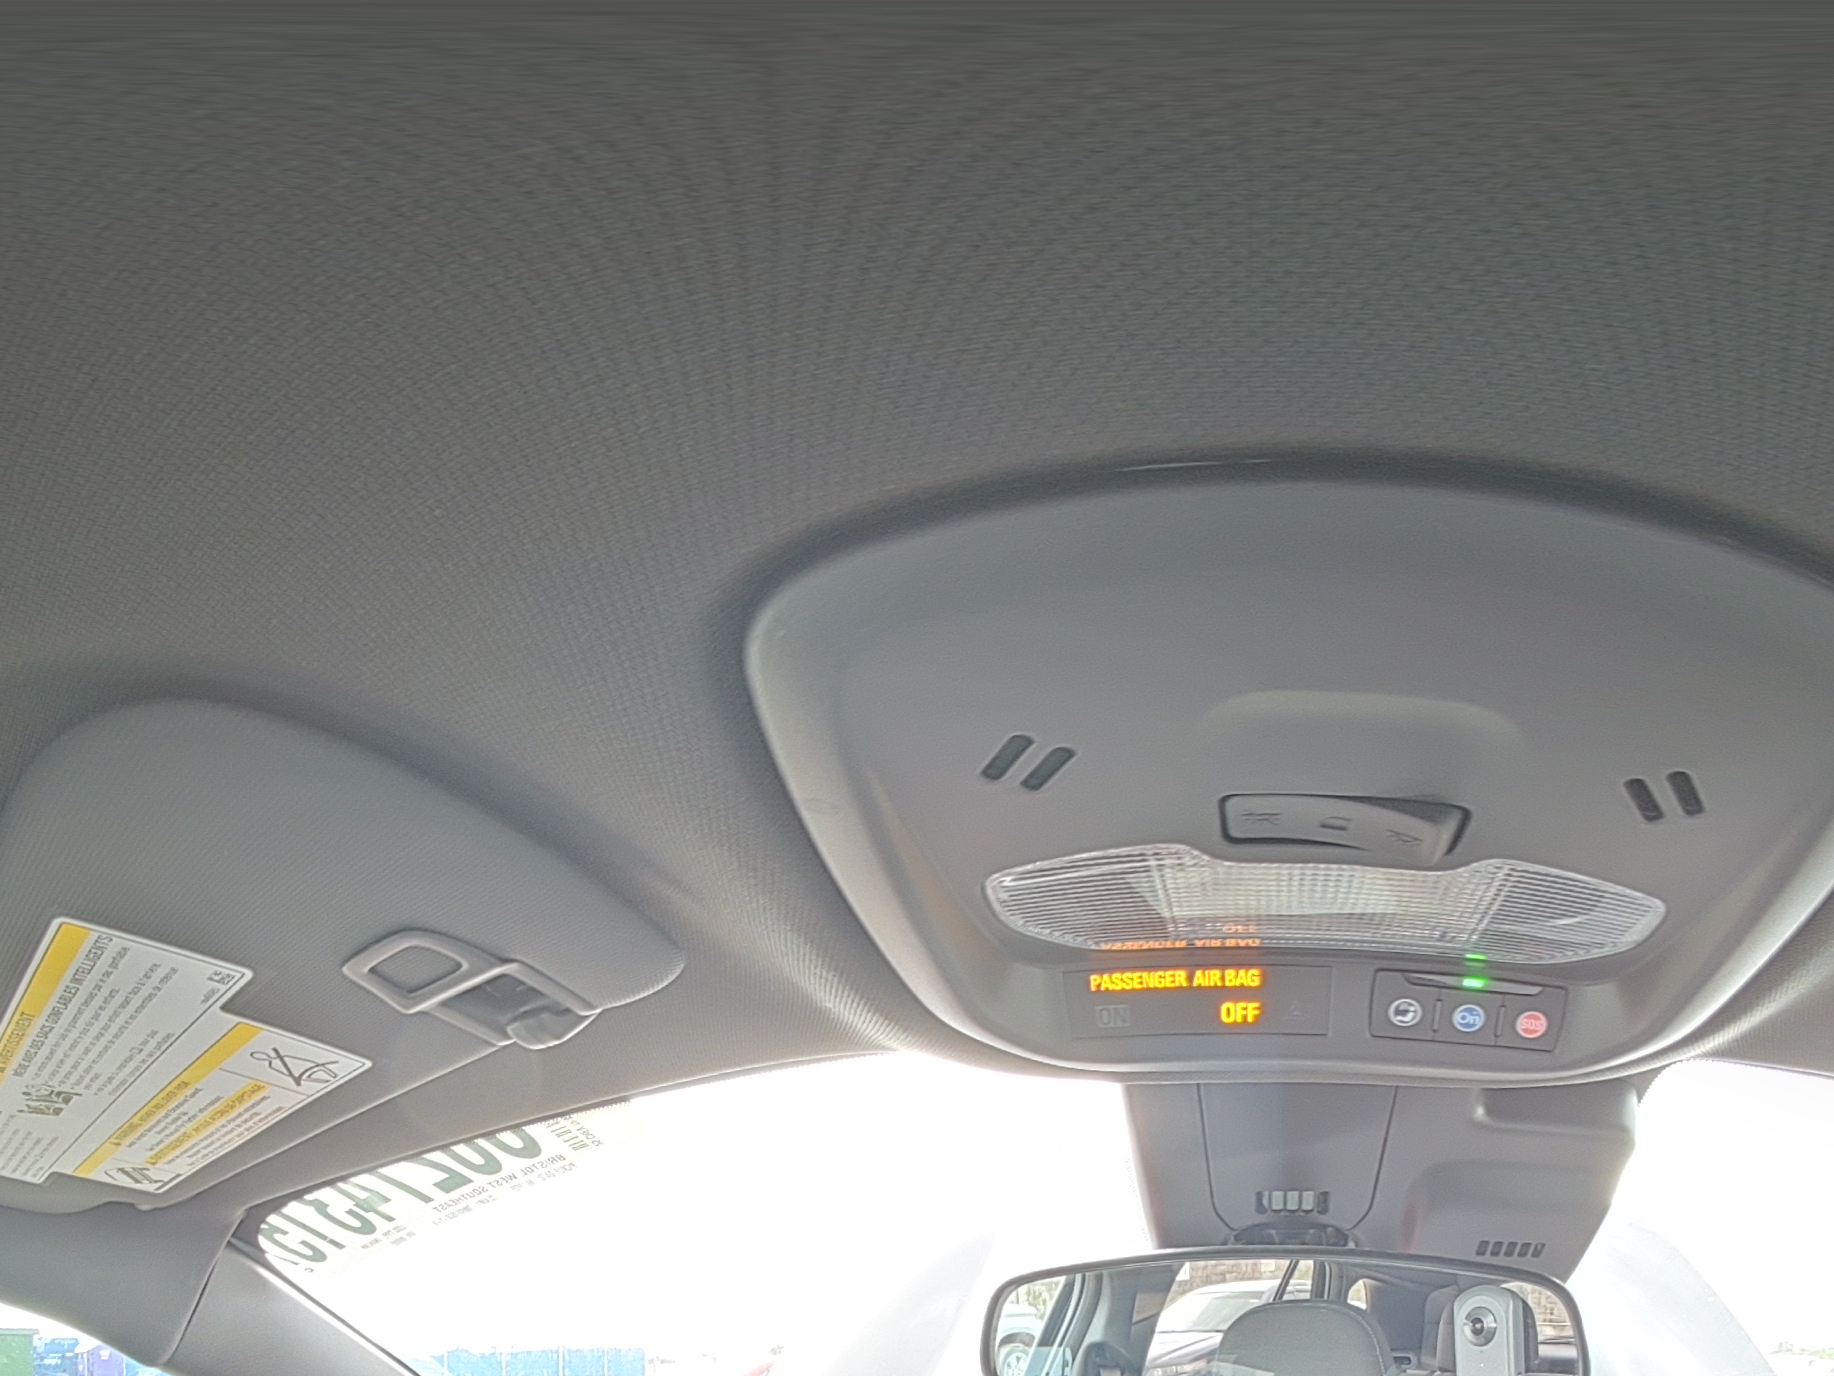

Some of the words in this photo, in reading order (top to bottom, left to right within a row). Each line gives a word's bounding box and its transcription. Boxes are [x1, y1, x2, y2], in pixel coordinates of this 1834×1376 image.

[70, 934, 114, 986] INTELLIGENTS
[1090, 970, 1188, 991] PASSENGER
[1193, 969, 1222, 987] AIR
[1225, 969, 1261, 987] BAG
[1098, 1007, 1129, 1026] ON
[1221, 1002, 1261, 1023] OFF
[1457, 1011, 1480, 1025] On
[1520, 1018, 1544, 1030] SOS
